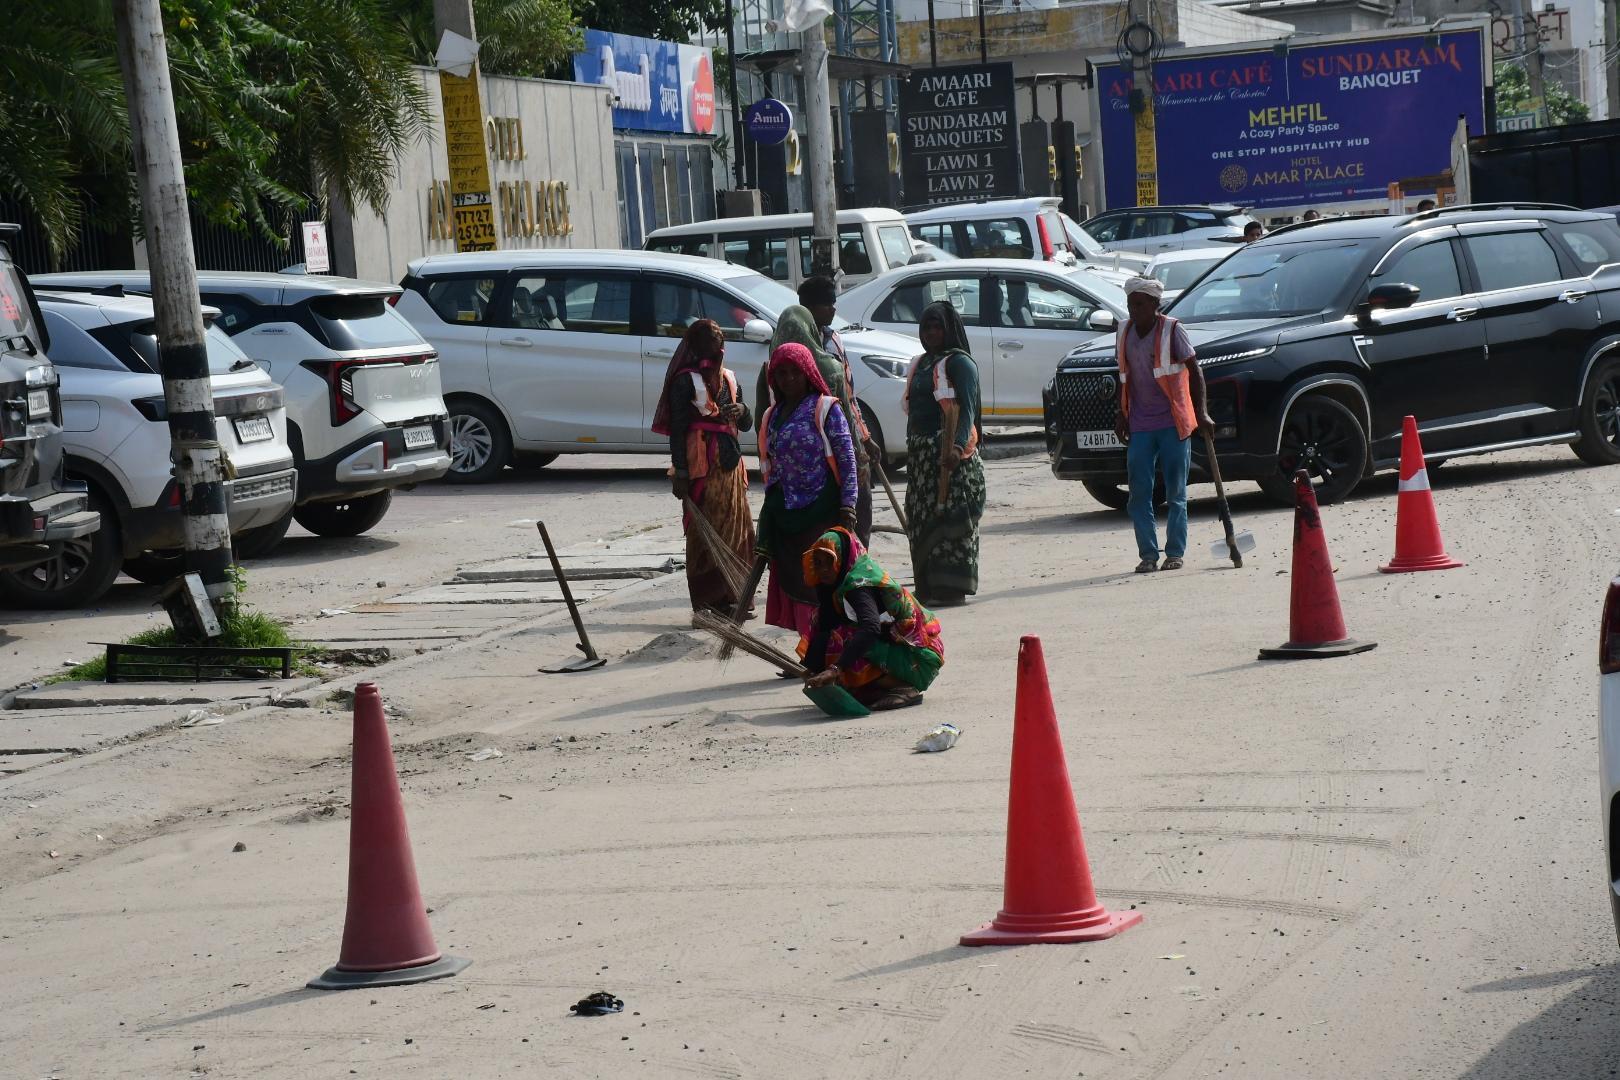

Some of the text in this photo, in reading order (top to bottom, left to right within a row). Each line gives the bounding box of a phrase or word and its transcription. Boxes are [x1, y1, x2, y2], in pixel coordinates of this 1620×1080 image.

[1301, 43, 1462, 78] SUNDARAM
[919, 73, 992, 92] AMAARI
[1209, 60, 1272, 89] CAFÉ
[1339, 69, 1422, 91] BANQUET
[934, 90, 979, 108] CAFE
[752, 112, 784, 124] Amul
[907, 110, 1008, 132] SUNDARAM
[1249, 102, 1328, 127] MEHFIL
[914, 128, 1003, 148] BANQUETS
[1239, 122, 1340, 140] A Cozy Party Space
[1211, 137, 1371, 160] ONE STOP HOSPITALITY HUB
[926, 152, 994, 171] LAWN 1
[1291, 156, 1322, 167] HOTEL
[927, 173, 995, 193] LAWN 2
[1252, 170, 1300, 186] AMAR
[1304, 163, 1366, 182] PALACE
[457, 223, 496, 241] 25272
